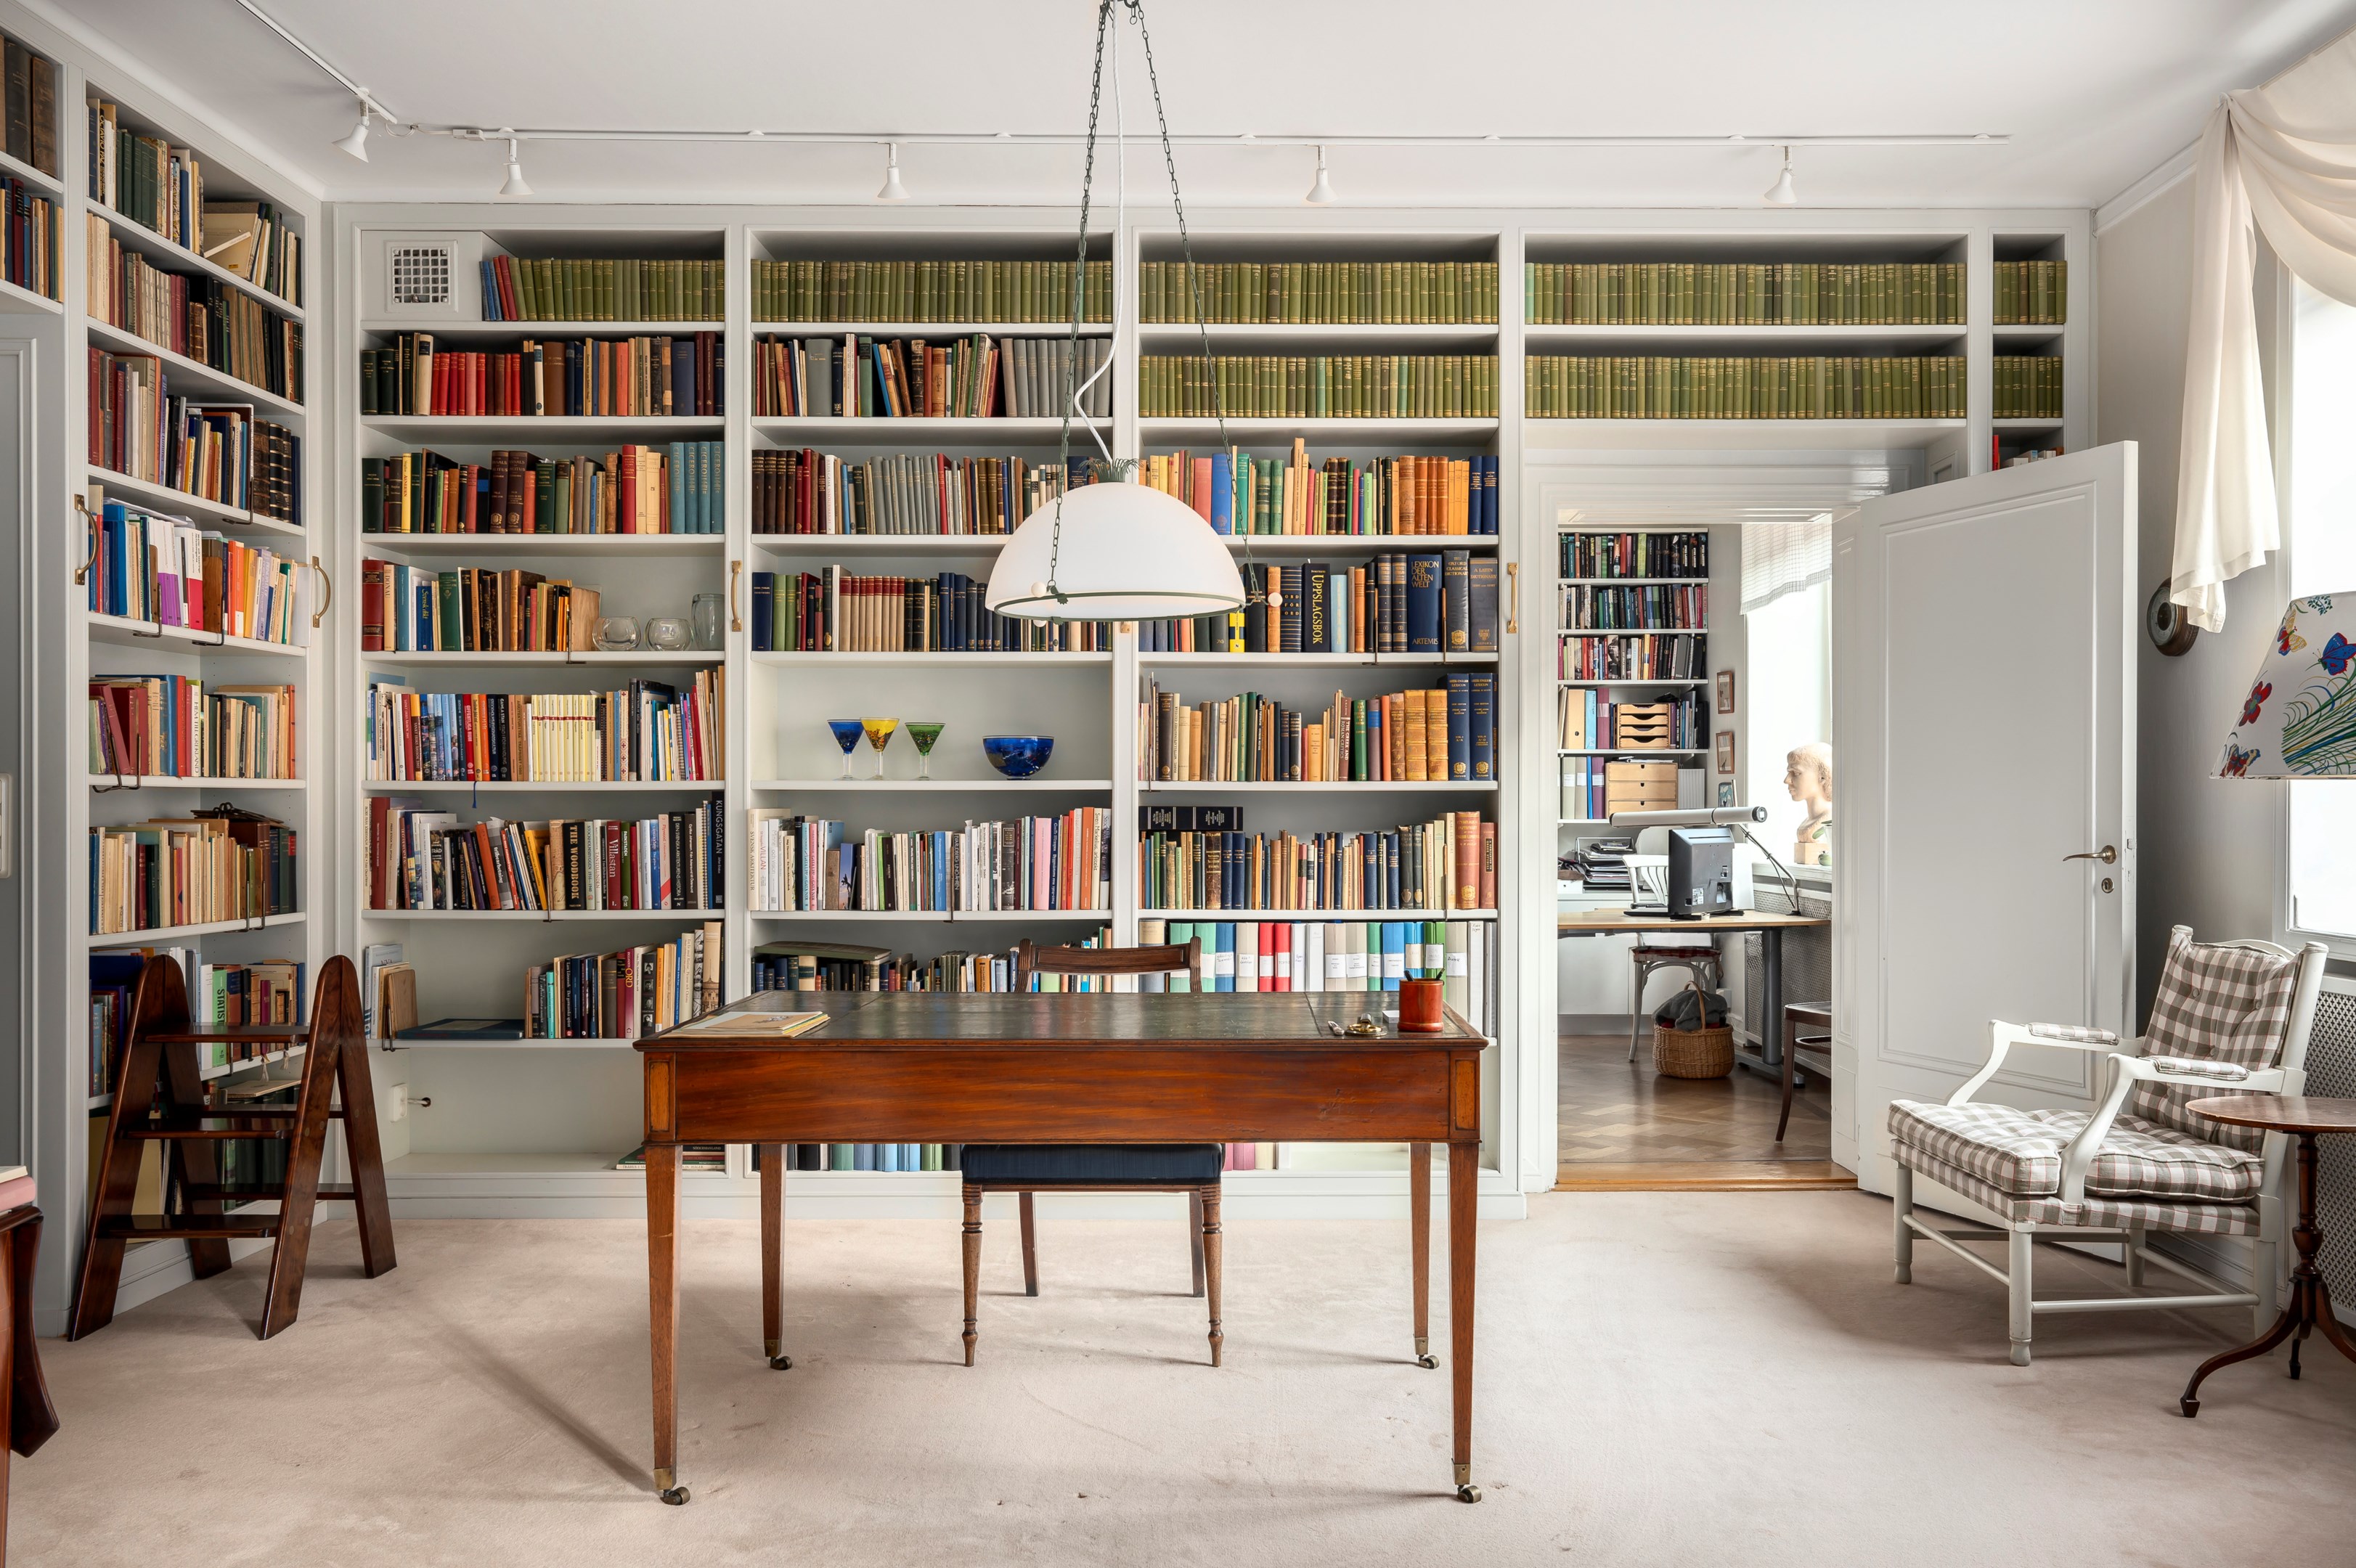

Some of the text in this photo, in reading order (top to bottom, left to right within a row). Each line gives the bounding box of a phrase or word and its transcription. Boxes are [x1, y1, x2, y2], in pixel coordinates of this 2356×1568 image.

[1311, 575, 1324, 645] UPPSLAGSBOK
[571, 847, 579, 899] WOODBOOK
[610, 839, 619, 877] Villastan
